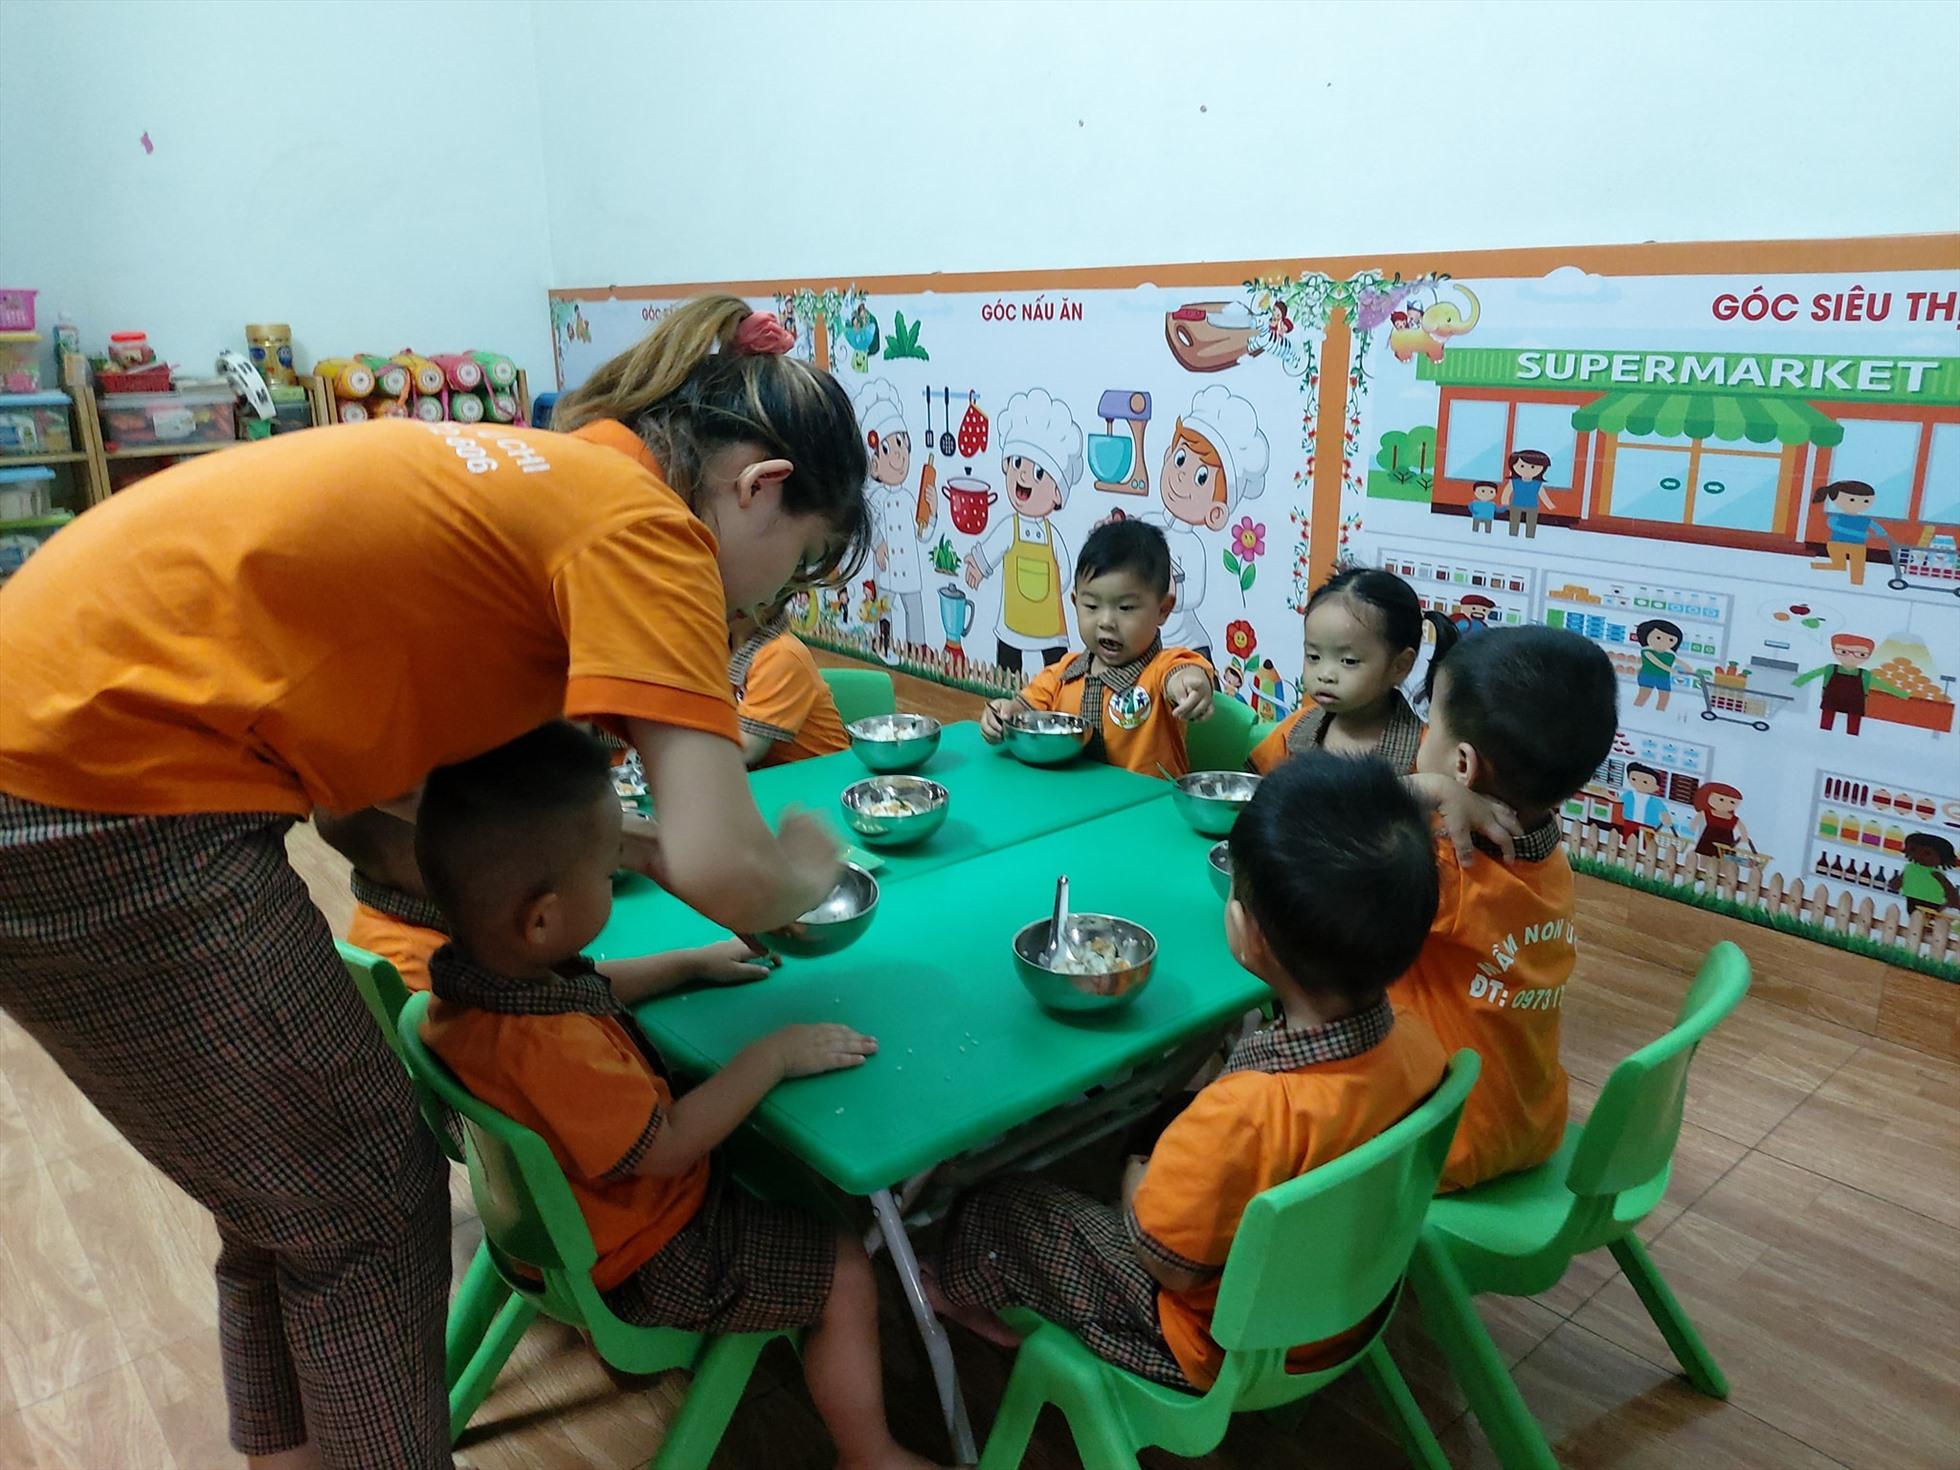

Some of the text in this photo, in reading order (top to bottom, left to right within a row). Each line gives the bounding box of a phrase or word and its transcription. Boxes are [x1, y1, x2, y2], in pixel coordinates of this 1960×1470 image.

[982, 294, 1082, 321] GÓC NẤU ĂN
[1712, 285, 1799, 321] GÓC
[1811, 285, 1892, 322] SIÊU
[1516, 352, 1939, 393] SUPERMARKET
